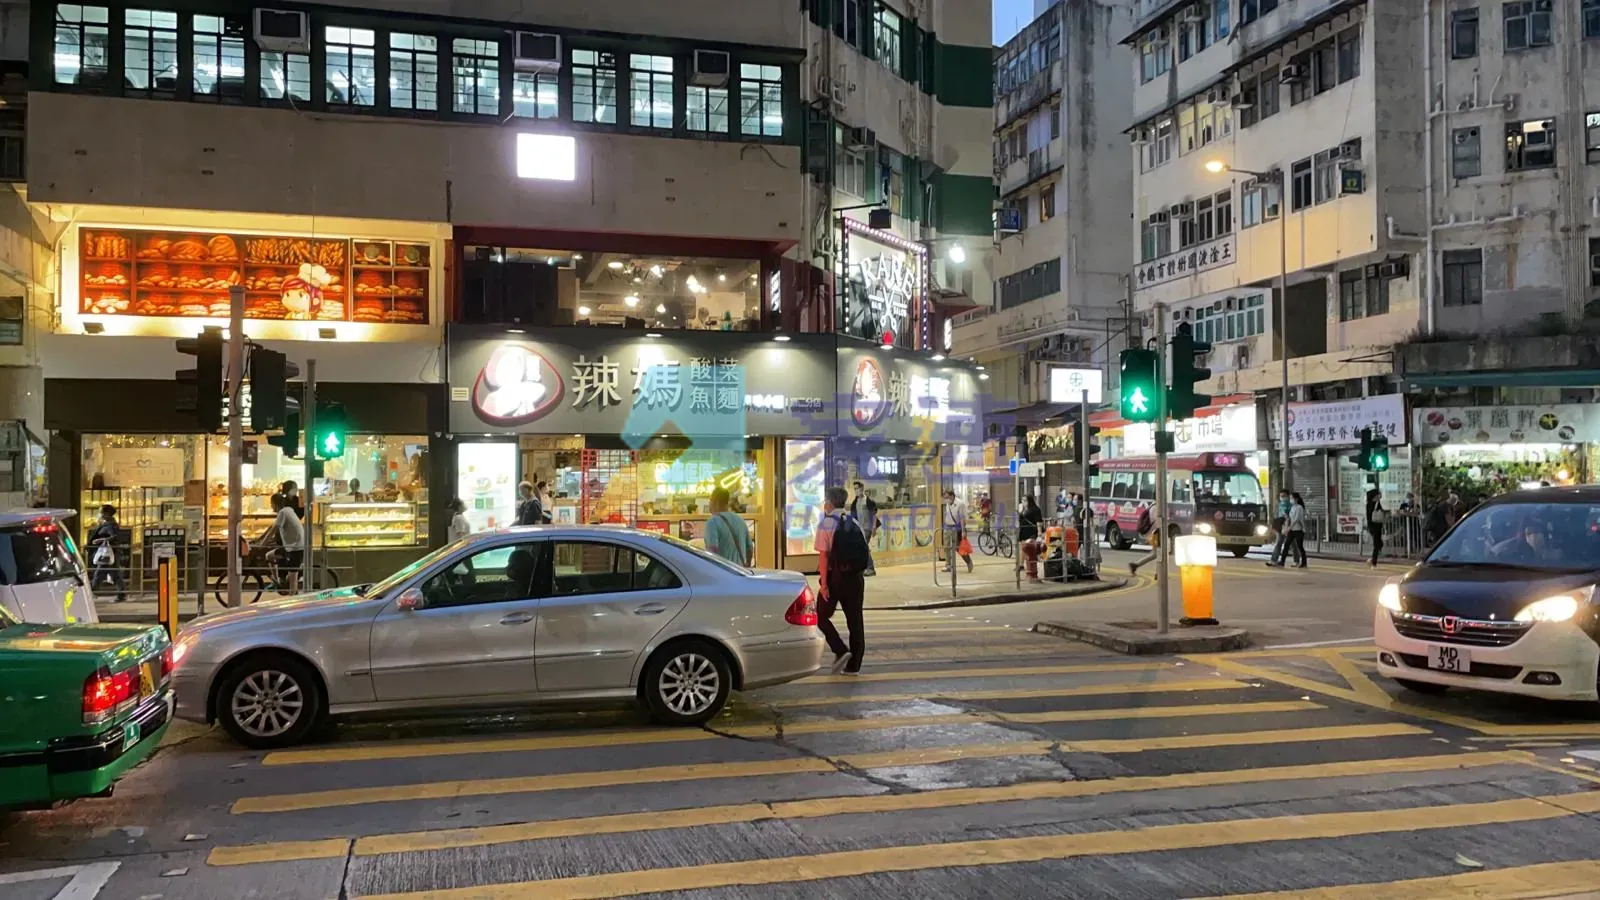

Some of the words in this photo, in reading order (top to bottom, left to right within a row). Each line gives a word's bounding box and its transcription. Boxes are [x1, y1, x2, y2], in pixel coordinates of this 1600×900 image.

[689, 356, 739, 381] 酸菜
[571, 353, 682, 408] 辣媽
[1439, 646, 1459, 660] MD
[1437, 656, 1461, 672] 351
